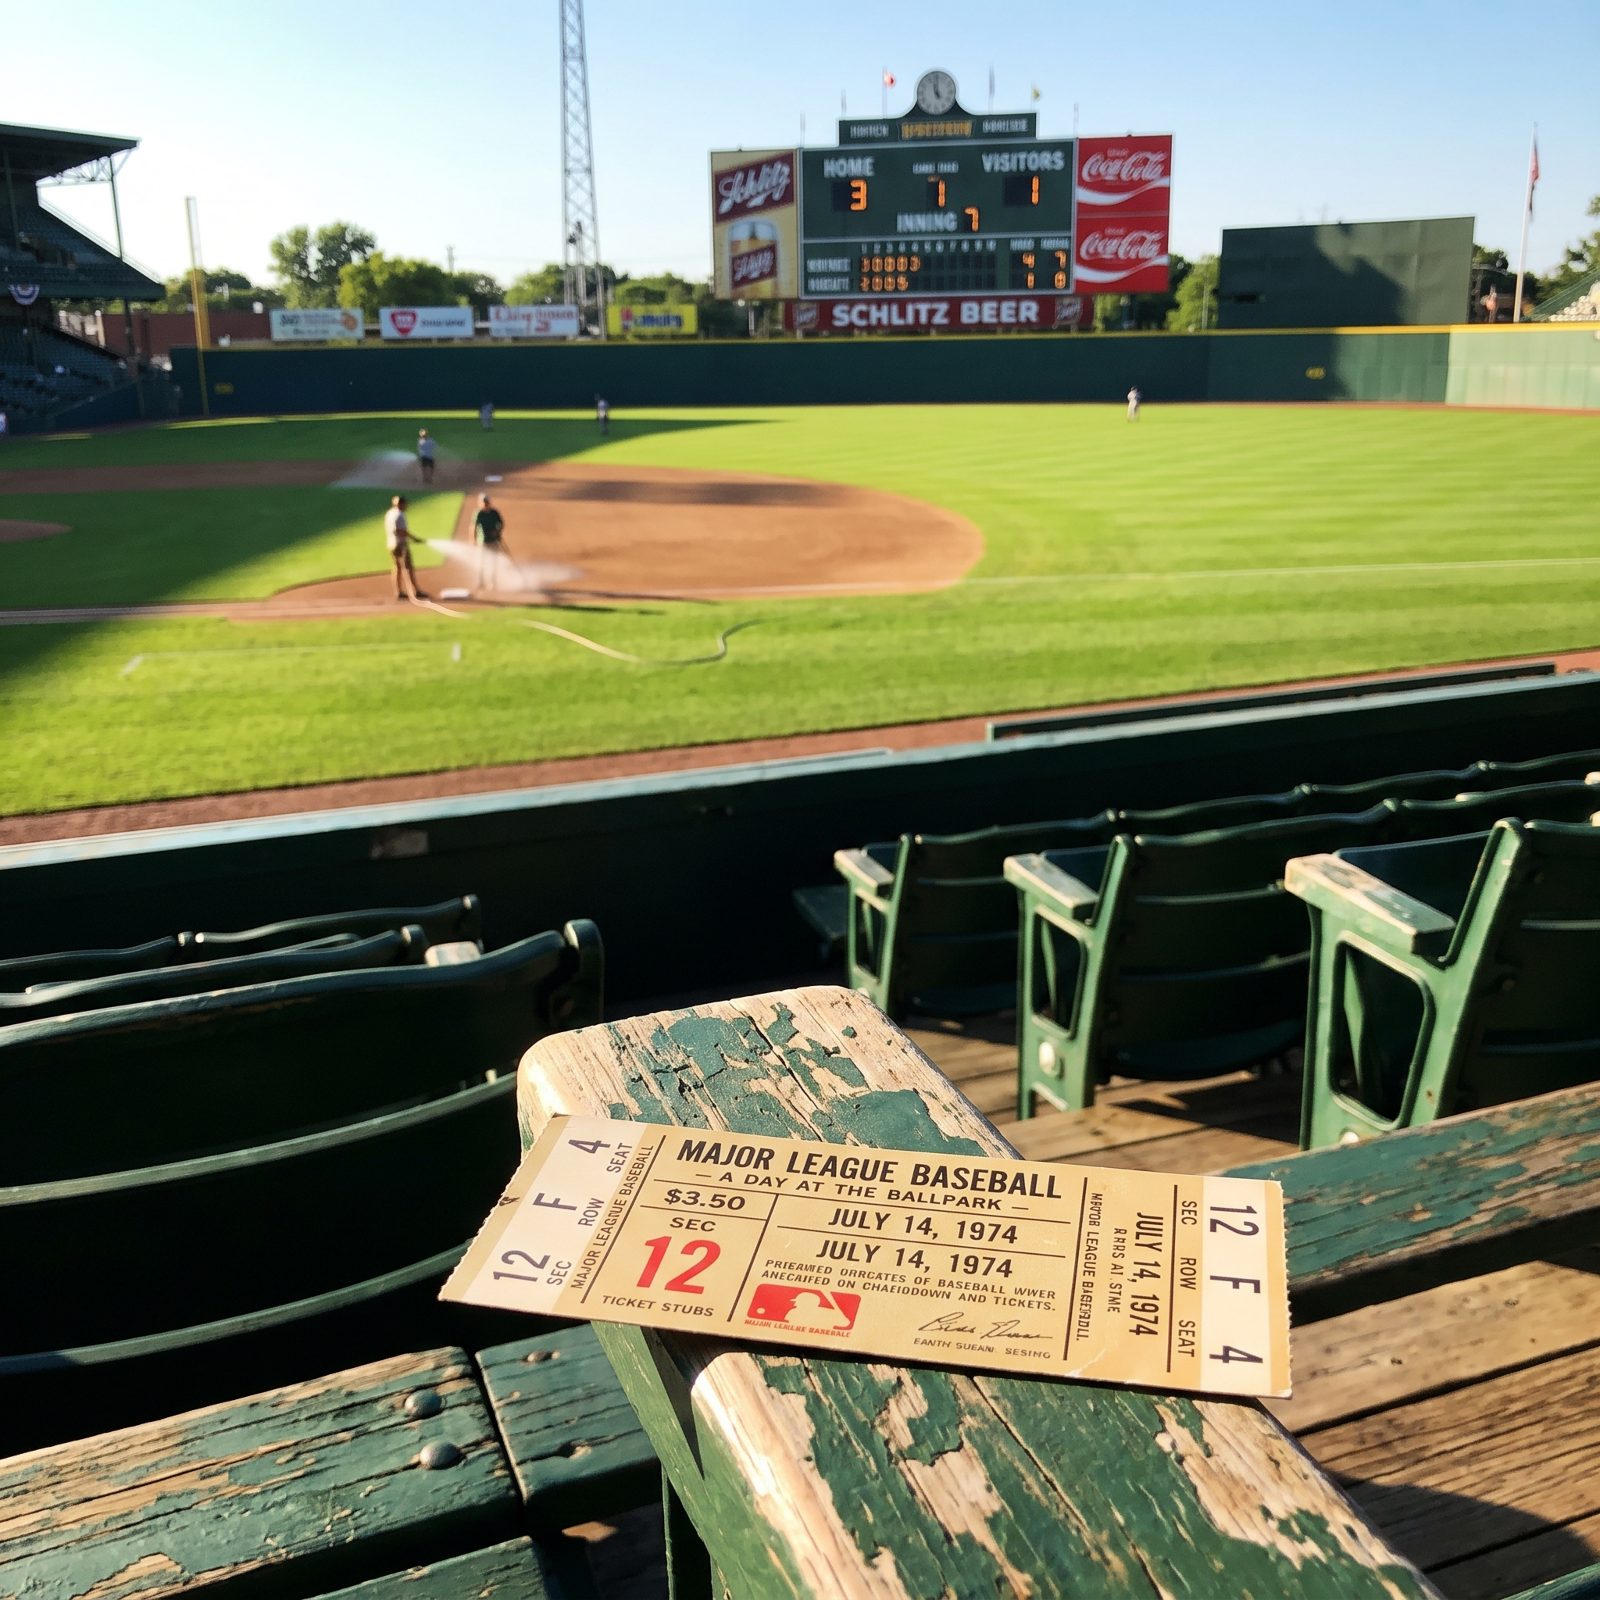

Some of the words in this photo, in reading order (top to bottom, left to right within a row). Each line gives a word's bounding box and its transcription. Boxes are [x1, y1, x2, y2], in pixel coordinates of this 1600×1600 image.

[823, 157, 875, 178] HOME
[982, 151, 1065, 172] VISITORS
[850, 179, 867, 211] 3
[1031, 175, 1040, 206] 1
[897, 211, 958, 233] INNING
[964, 206, 979, 232] 7
[832, 302, 949, 327] SCHLITZ
[960, 300, 1039, 325] BEER
[568, 1139, 611, 1154] 4
[606, 1143, 633, 1173] SEAT
[676, 1139, 775, 1170] MAJOR
[786, 1151, 898, 1183] LEAGUE
[910, 1163, 1062, 1199] BASEBALL
[532, 1192, 578, 1211] F
[664, 1187, 746, 1211] $3.50
[718, 1172, 733, 1183] A
[744, 1174, 788, 1188] DAY
[795, 1180, 824, 1193] AT
[834, 1183, 877, 1198] THE
[887, 1189, 1003, 1210] BALLPARK
[570, 1249, 601, 1290] MAJOR
[619, 1145, 654, 1196] BASEBALL
[578, 1197, 605, 1227] ROW
[669, 1216, 717, 1232] SEC
[828, 1207, 892, 1231] JULY
[904, 1215, 939, 1240] 14,
[956, 1220, 1018, 1244] 1974
[1181, 1200, 1198, 1226] SEC
[1209, 1205, 1260, 1237] 12
[1134, 1211, 1164, 1253] JULY
[492, 1249, 551, 1282] 12
[635, 1235, 721, 1295] 12
[816, 1239, 882, 1264] JULY
[895, 1247, 931, 1274] 14,
[950, 1253, 1013, 1278] 1974
[1082, 1231, 1099, 1278] LEAGUE
[546, 1260, 573, 1286] SEC
[913, 1276, 931, 1286] OF
[937, 1279, 1006, 1294] BASEBALL
[1127, 1261, 1162, 1283] 14,
[1179, 1256, 1197, 1290] ROW
[1209, 1275, 1261, 1294] F
[601, 1295, 657, 1311] TICKET
[661, 1302, 716, 1318] STUBS
[837, 1279, 856, 1288] ON
[958, 1293, 987, 1303] AND
[994, 1296, 1056, 1311] TICKETS.
[1128, 1294, 1160, 1336] 1974
[1177, 1318, 1196, 1358] SEAT
[1209, 1345, 1264, 1364] 4
